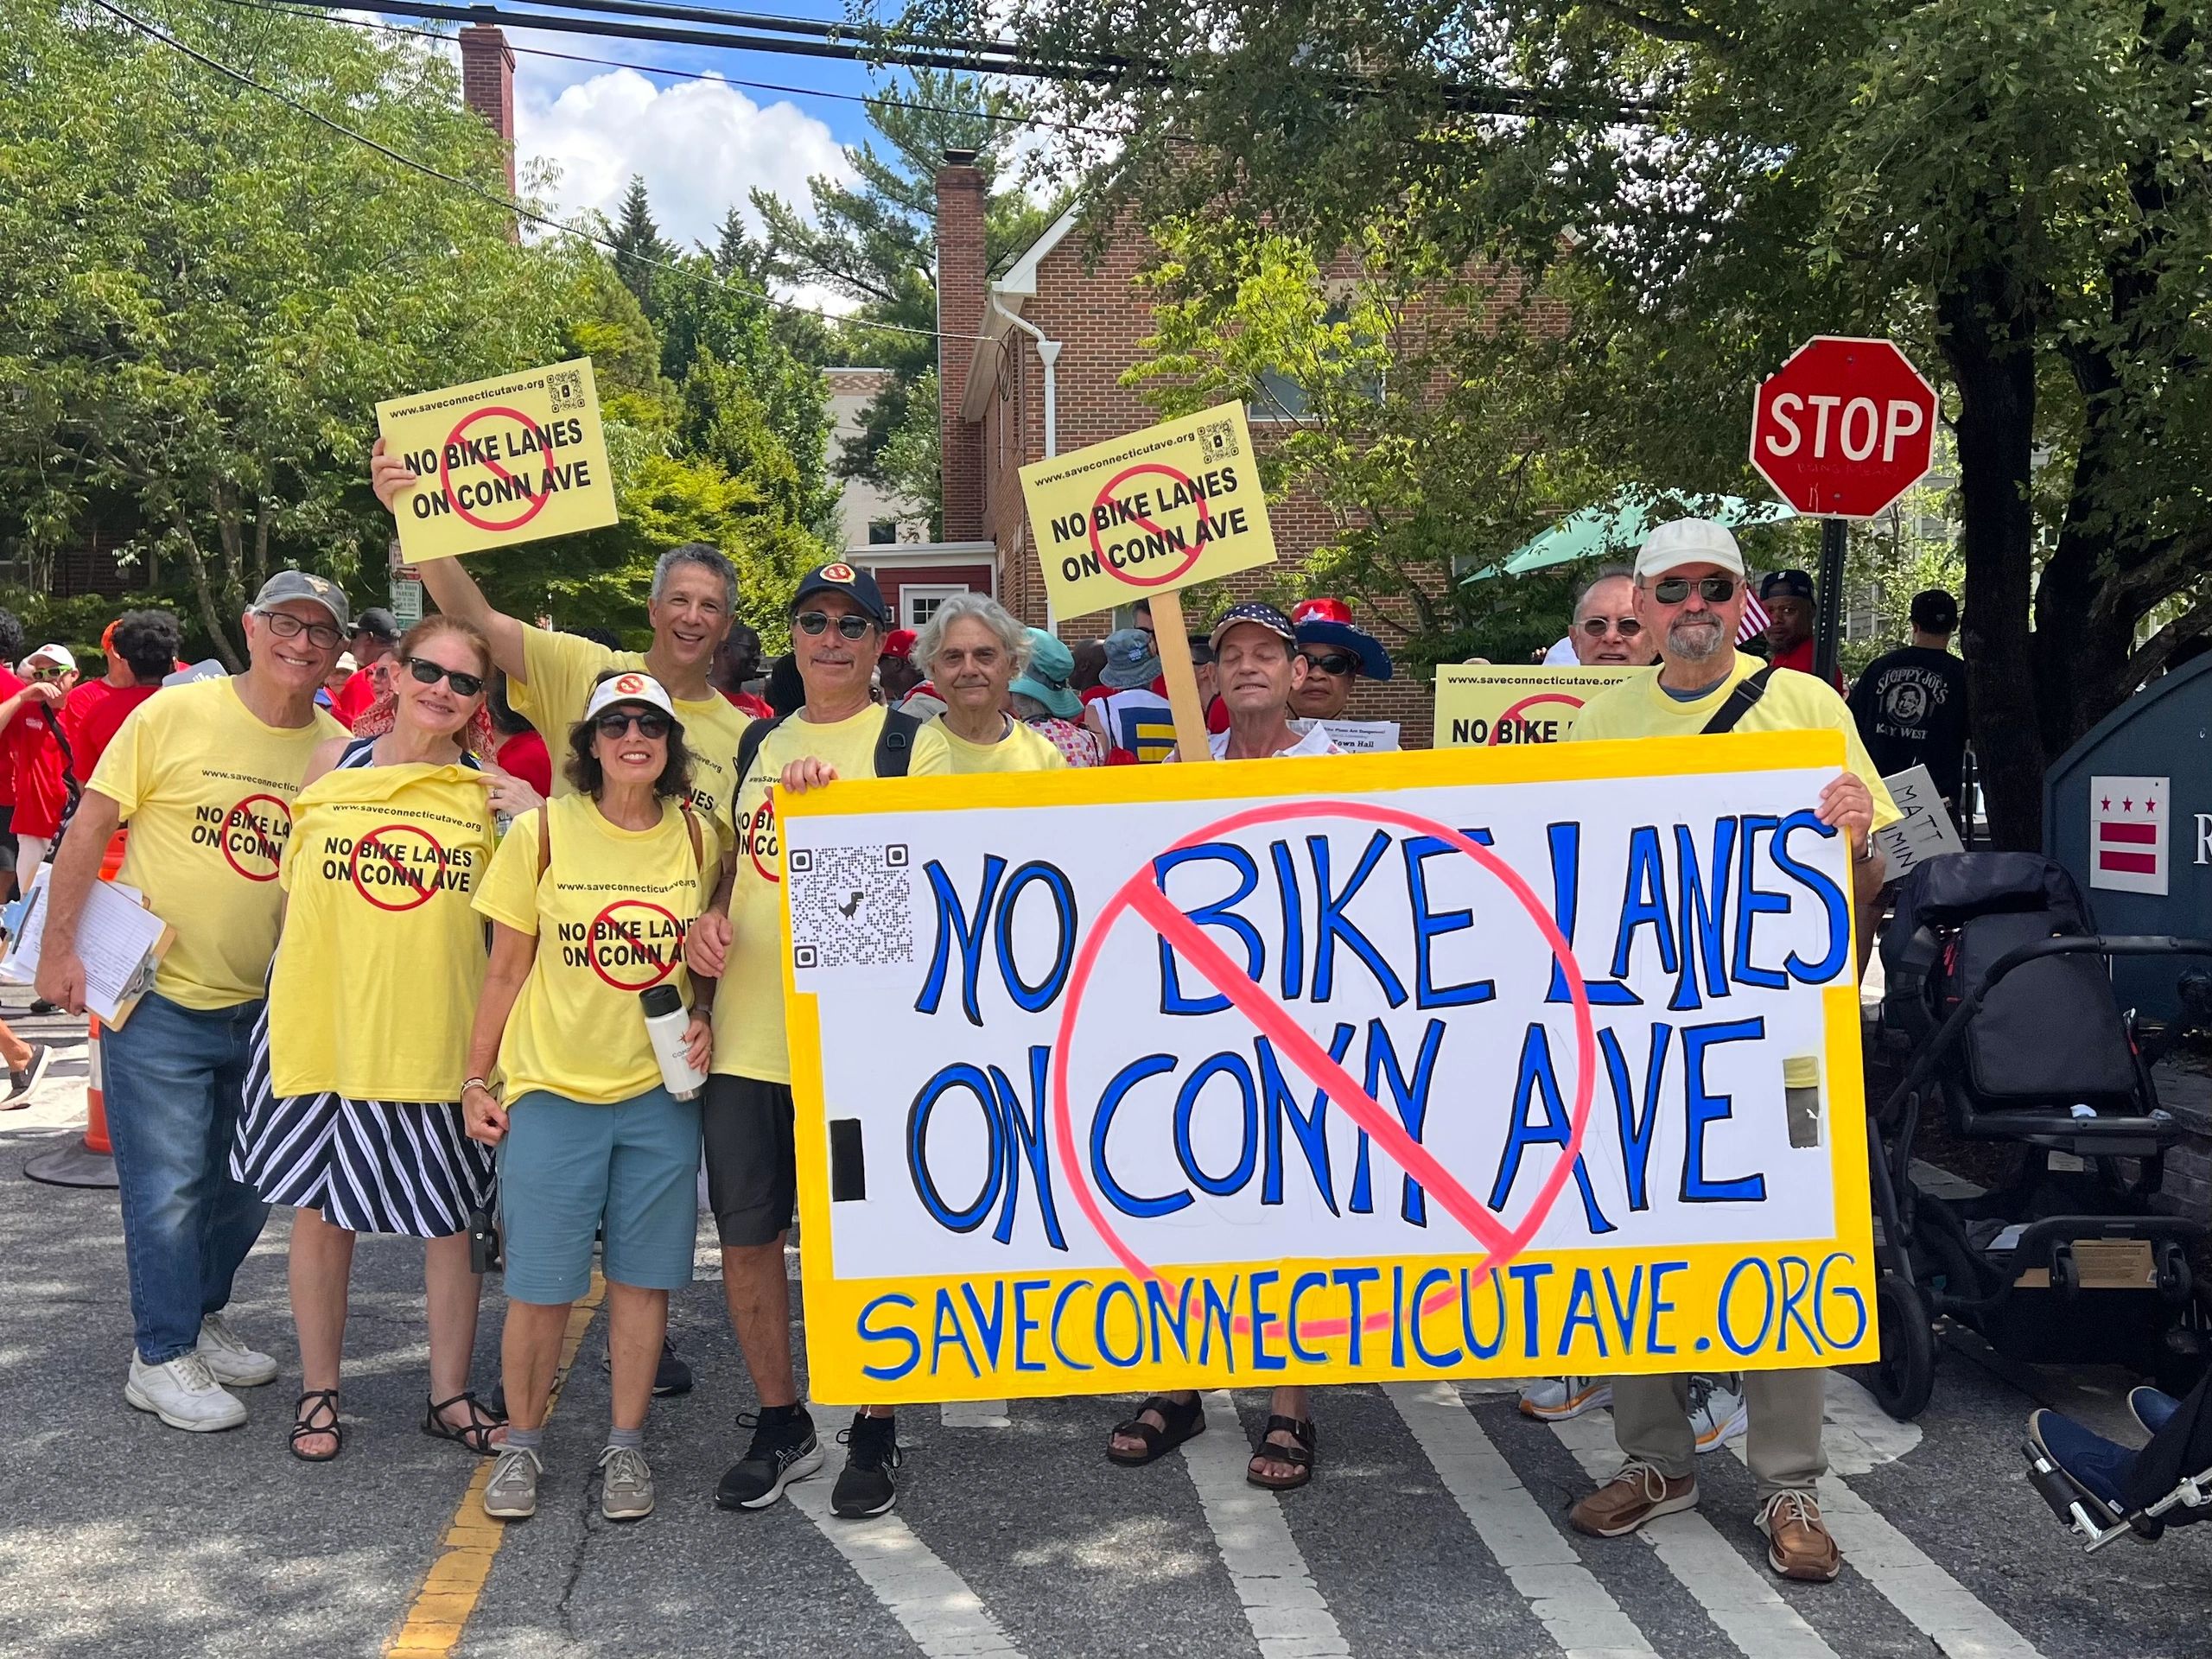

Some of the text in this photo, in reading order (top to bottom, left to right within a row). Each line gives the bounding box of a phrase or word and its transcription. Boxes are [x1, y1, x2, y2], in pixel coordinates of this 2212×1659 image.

[389, 378, 545, 419] www.saveconnecticutave.org
[1764, 392, 1923, 462] STOP
[404, 417, 584, 477] NO BIKE LANES
[1034, 431, 1196, 487] www.saveconnecticutave.org
[412, 460, 592, 519] ON CONN AVE
[1051, 466, 1238, 544] NO BIKE LANES
[1062, 506, 1249, 583] ON CONN AVE
[1876, 669, 1949, 705] SLOPPY JOE'S
[1332, 739, 1356, 747] Town
[1452, 718, 1558, 745] NO BIKE
[1901, 727, 1929, 740] WEST
[196, 805, 224, 824] NO
[229, 810, 269, 835] BIKE
[333, 804, 482, 833] www.saveconnecticutave.org
[1892, 784, 1943, 843] MATT
[191, 824, 283, 861] ON CONN
[324, 836, 473, 868] NO BIKE LANES
[322, 860, 471, 893] ON CONN AVE
[558, 922, 587, 942] NO
[594, 920, 642, 942] BIKE
[913, 808, 1851, 1027] NO BIKE LANES
[563, 945, 590, 968] ON
[598, 943, 663, 968] CONN
[906, 1015, 1768, 1253] ON CONN AVE
[856, 1252, 1867, 1382] SAVECONNECTICUTAVE.ORG
